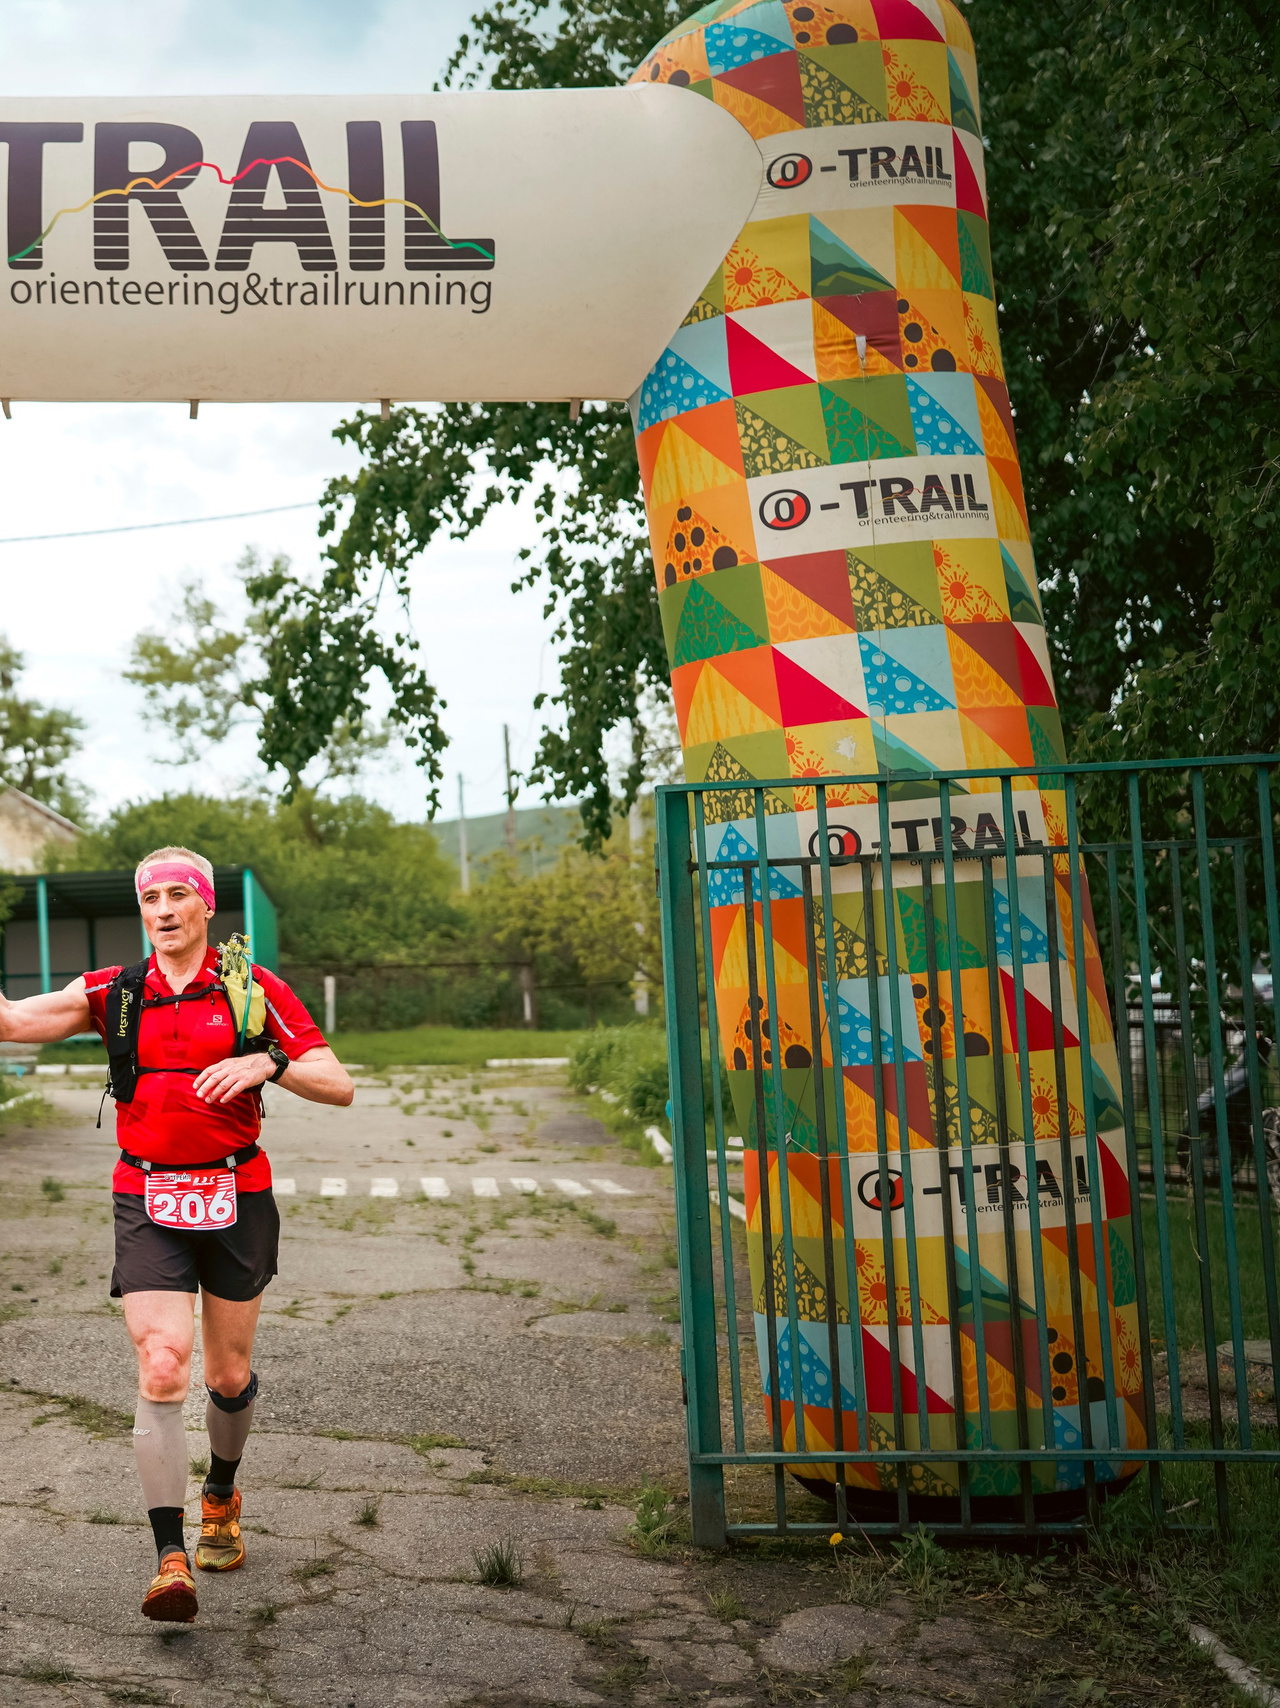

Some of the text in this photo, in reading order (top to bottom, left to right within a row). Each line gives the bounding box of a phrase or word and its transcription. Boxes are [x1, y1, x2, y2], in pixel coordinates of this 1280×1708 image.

[849, 176, 953, 188] orienteering&trailrunning
[10, 273, 494, 314] orienteering&trailrunning
[858, 510, 990, 527] orenteering&trailrunning
[153, 1190, 233, 1224] 206
